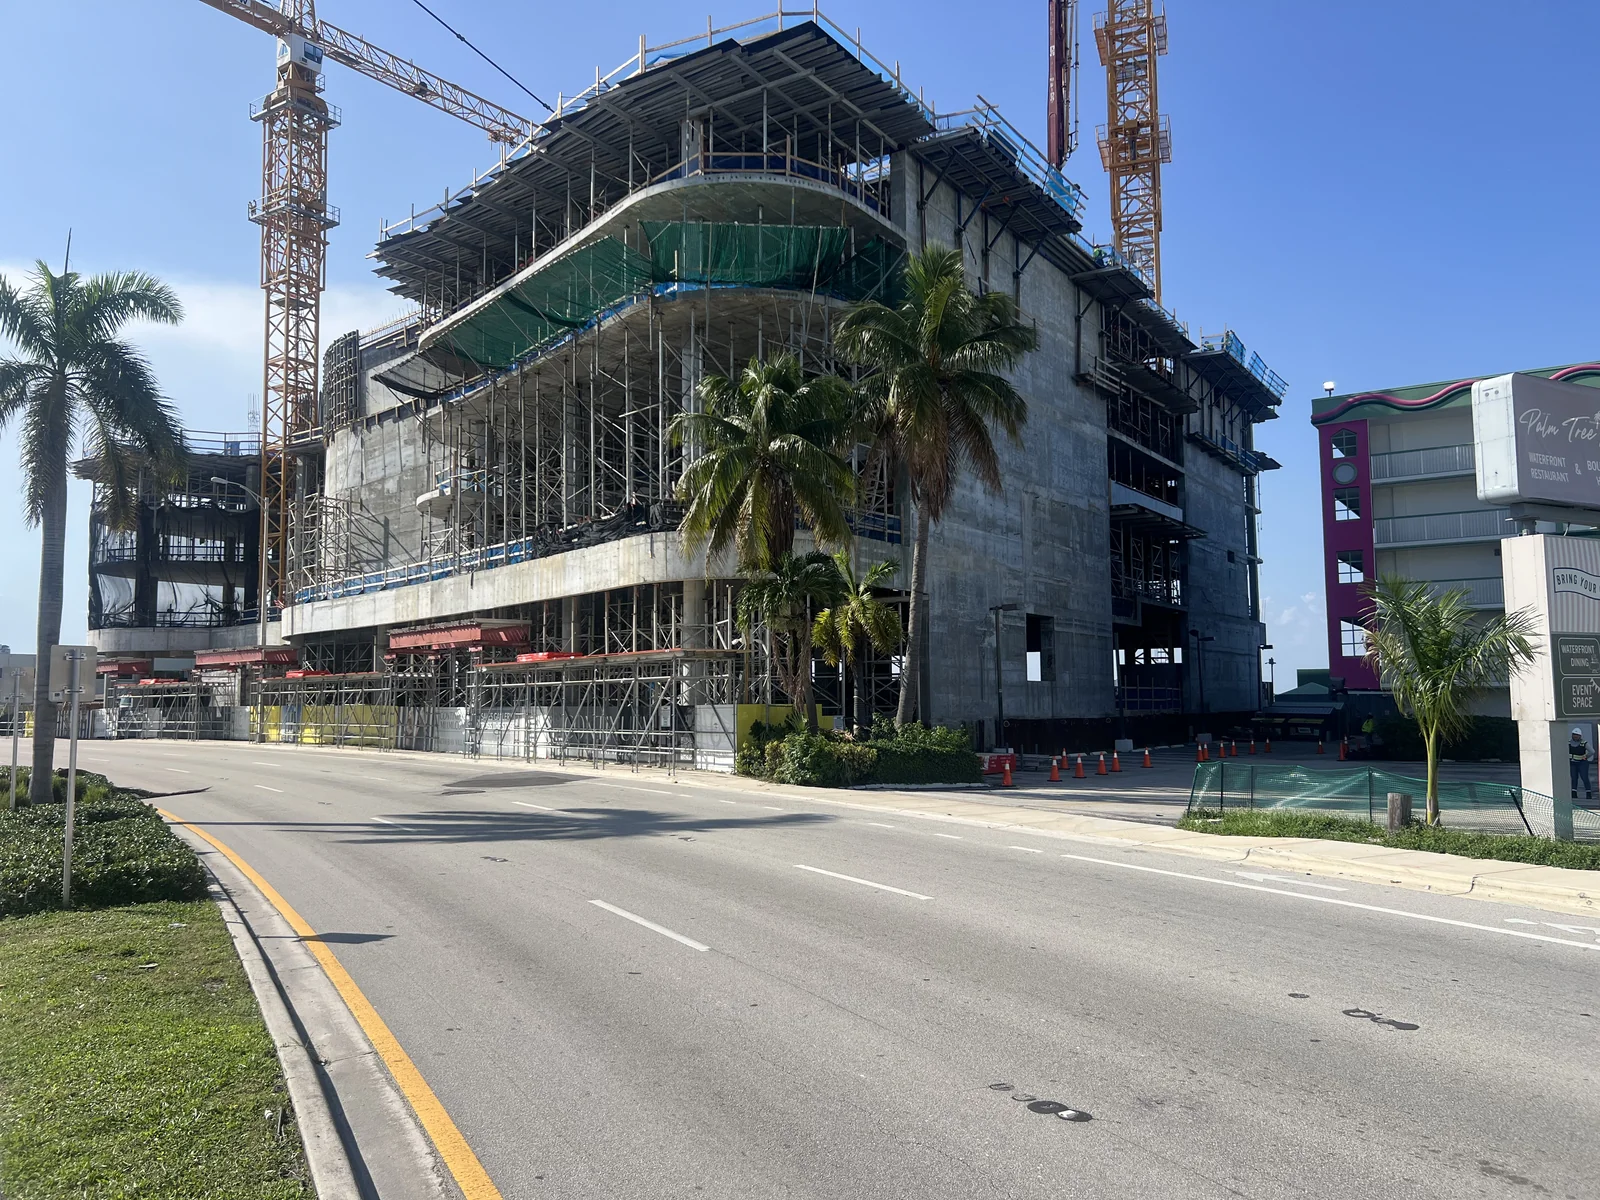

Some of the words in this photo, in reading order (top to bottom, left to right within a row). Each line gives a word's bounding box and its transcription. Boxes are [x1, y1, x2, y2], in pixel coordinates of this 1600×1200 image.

[1519, 408, 1559, 438] Palm
[1562, 416, 1597, 443] Tree
[1528, 452, 1566, 468] WATERFRONT
[1530, 467, 1569, 483] RESTAURANT
[1574, 463, 1582, 475] &
[1556, 573, 1578, 585] BRING
[1580, 577, 1597, 593] YOUR
[1560, 644, 1595, 654] WATERFRONT
[1570, 657, 1590, 667] DINING
[1572, 684, 1593, 696] EVENT
[1572, 696, 1593, 708] SPACE
